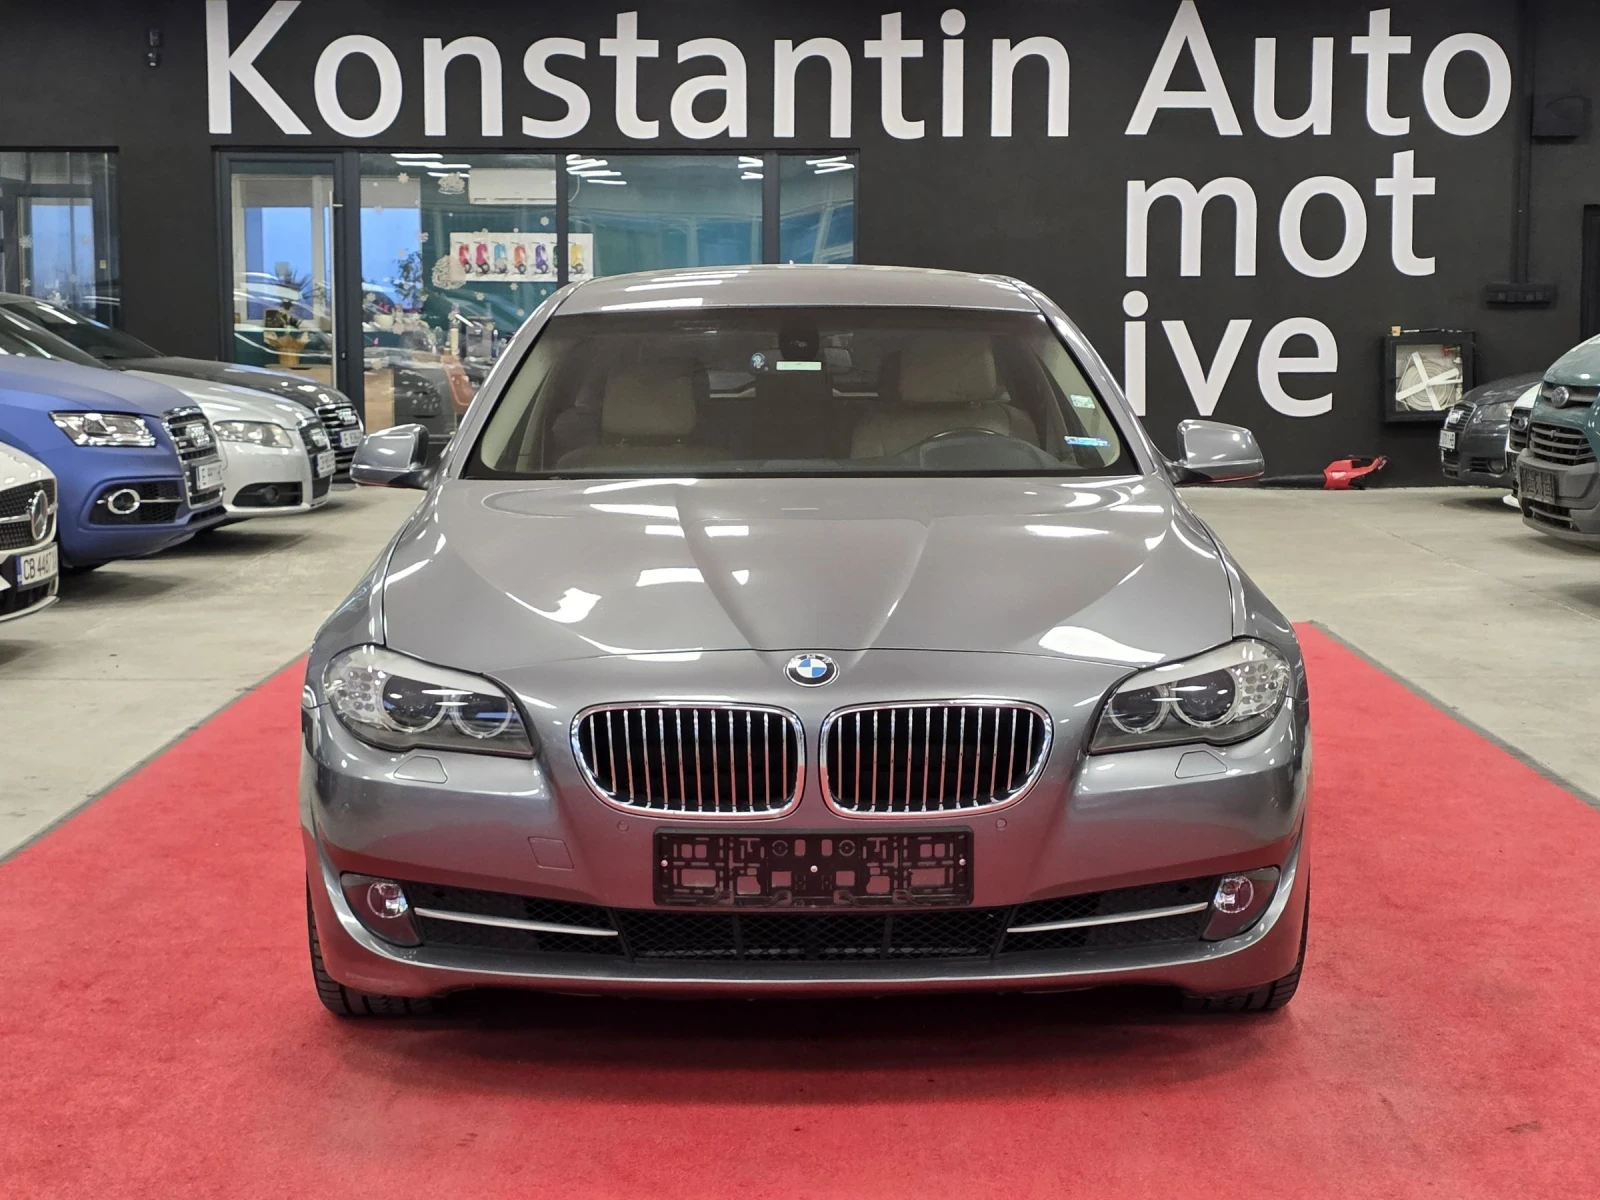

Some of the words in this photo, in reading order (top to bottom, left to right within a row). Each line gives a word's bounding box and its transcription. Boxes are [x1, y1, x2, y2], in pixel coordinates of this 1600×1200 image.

[206, 0, 1070, 140] Konstantin
[1125, 0, 1512, 138] Auto
[1126, 150, 1437, 278] mot
[1122, 290, 1339, 417] ive
[23, 557, 36, 581] CB
